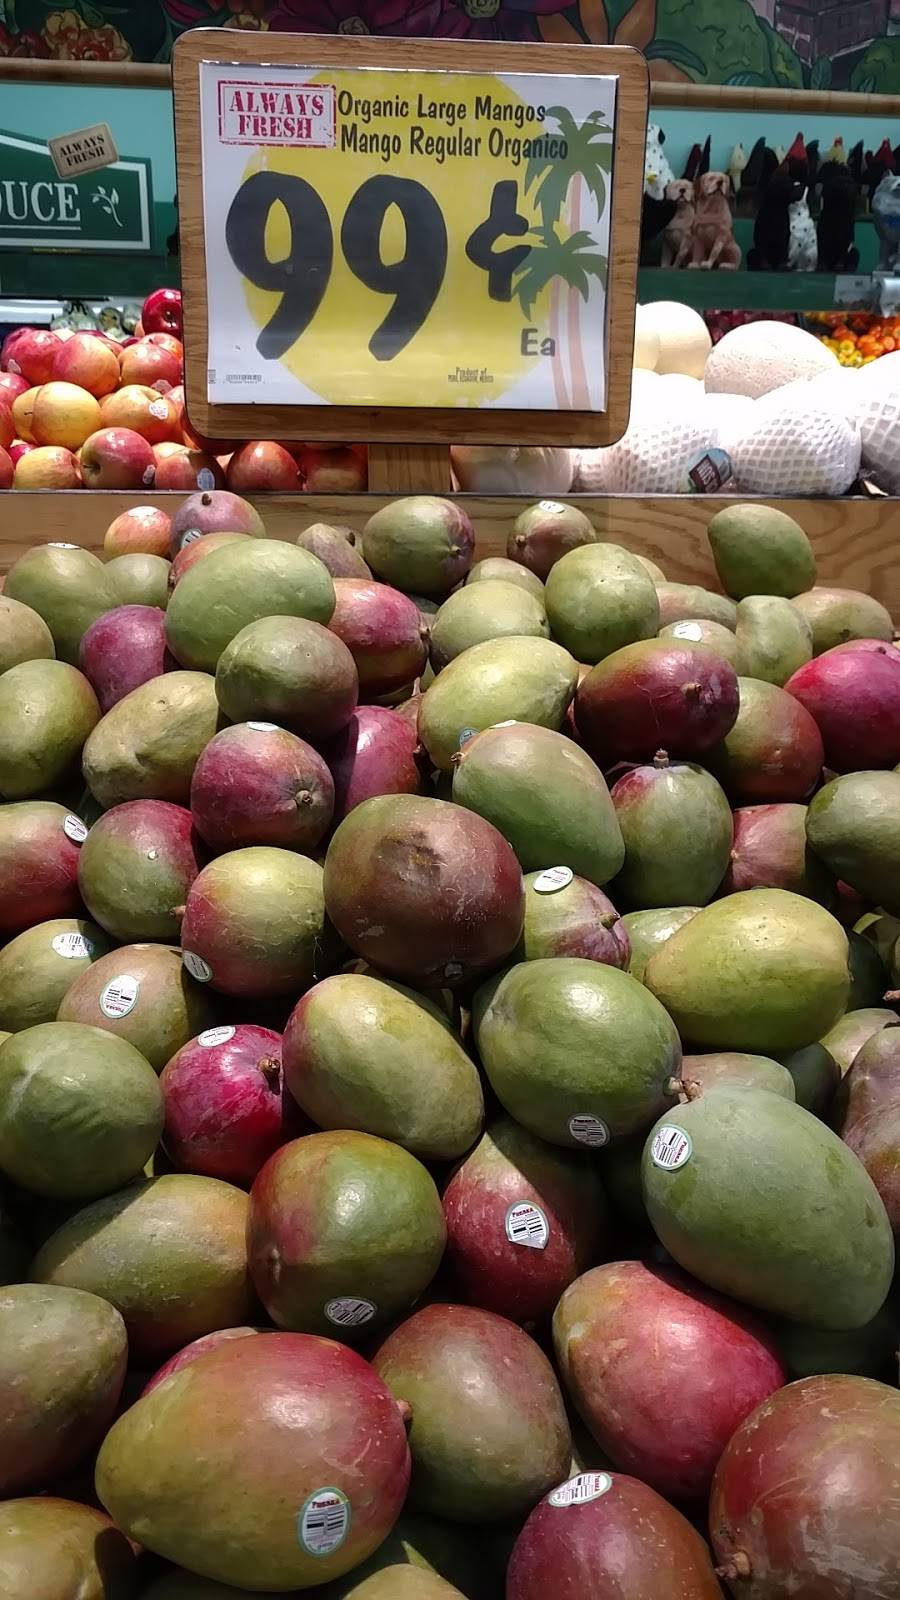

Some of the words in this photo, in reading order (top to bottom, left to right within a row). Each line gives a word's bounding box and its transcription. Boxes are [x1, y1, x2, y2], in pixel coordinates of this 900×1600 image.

[229, 90, 325, 117] ALWAYS
[338, 90, 408, 124] Organic
[417, 93, 467, 127] Large
[475, 94, 546, 129] Mangos
[238, 114, 313, 139] FRESH
[59, 133, 105, 158] ALWAYS
[65, 146, 105, 167] FRESH
[341, 122, 402, 162] Mango
[410, 125, 482, 165] Regular
[488, 127, 568, 167] Organico
[0, 180, 81, 222] UCE
[520, 327, 556, 357] Ea
